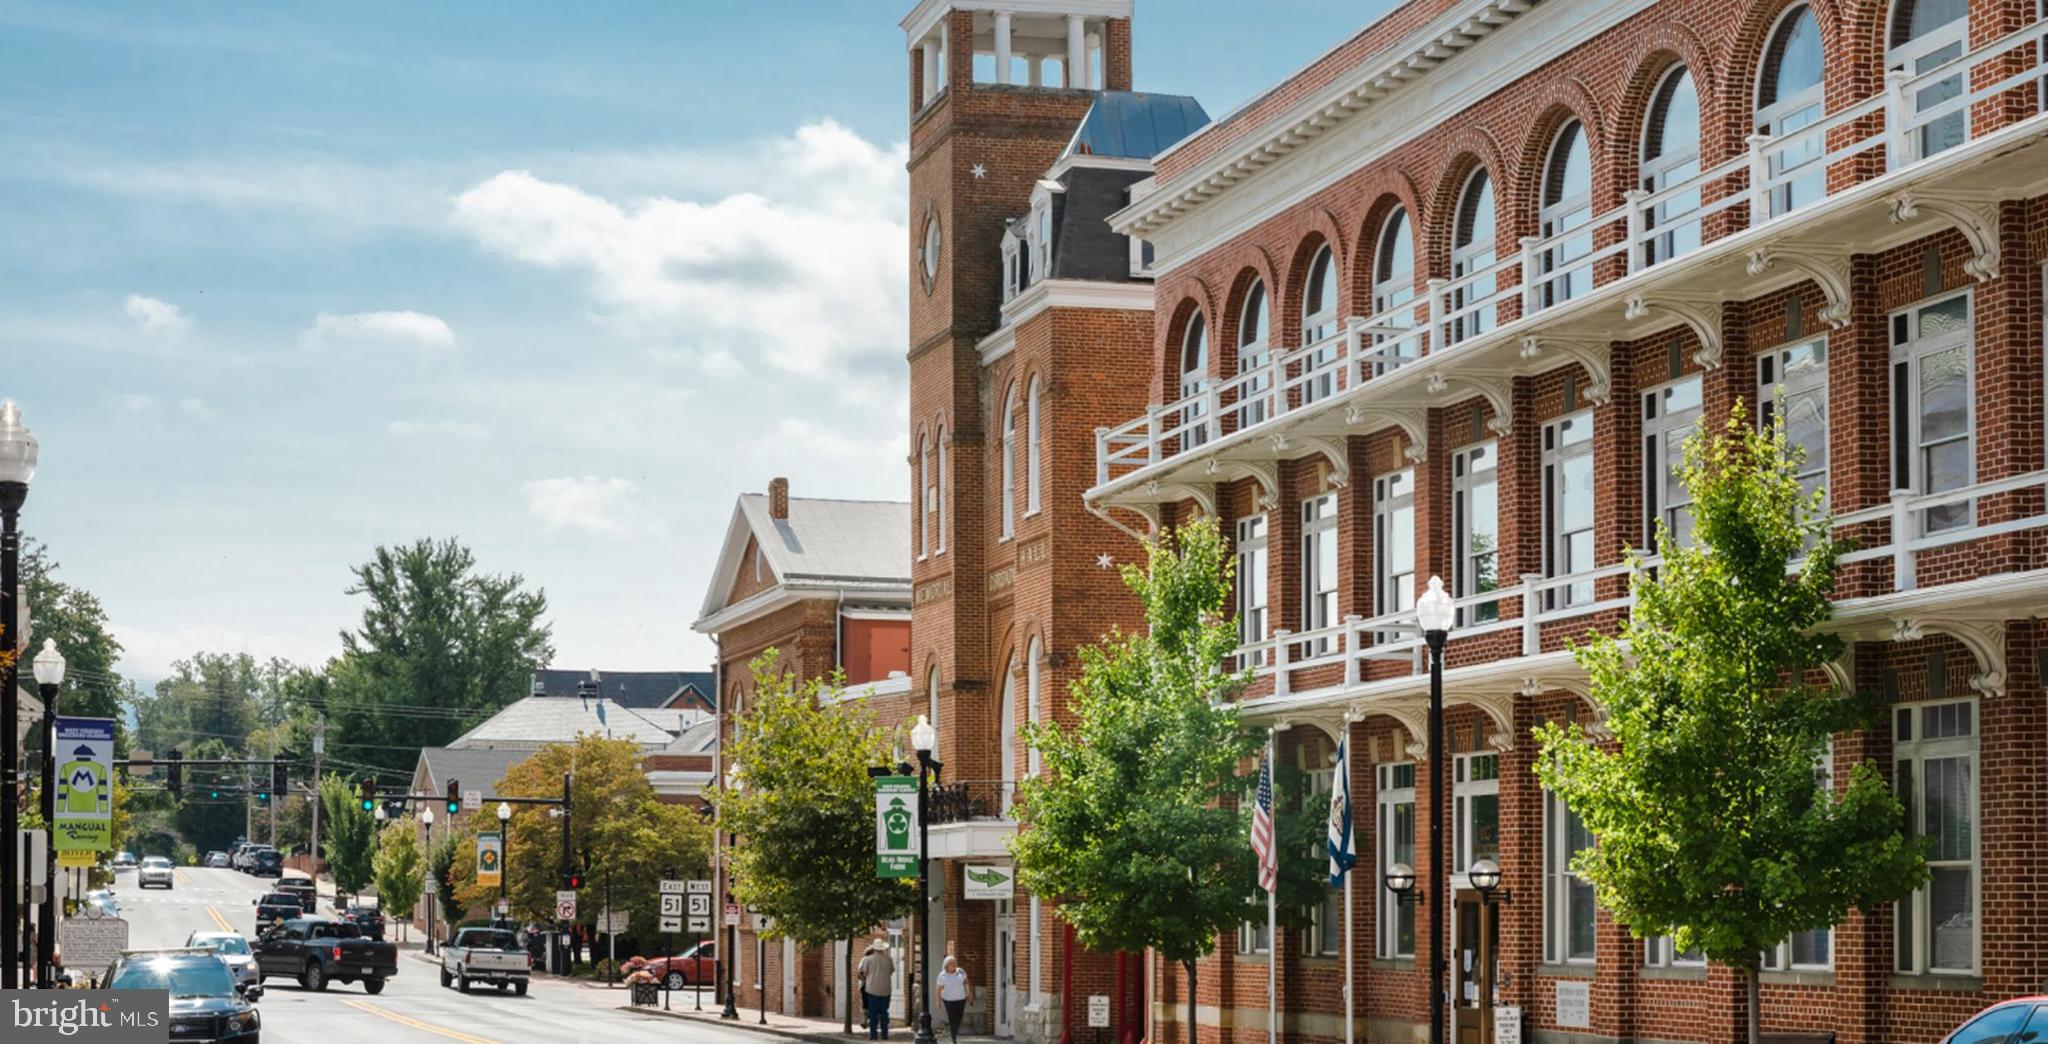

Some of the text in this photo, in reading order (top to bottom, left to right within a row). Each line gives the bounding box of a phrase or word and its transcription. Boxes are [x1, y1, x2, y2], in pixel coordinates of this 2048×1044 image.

[72, 770, 94, 786] M
[59, 822, 106, 831] MANGUAL
[664, 898, 680, 912] 51
[692, 898, 708, 912] 51
